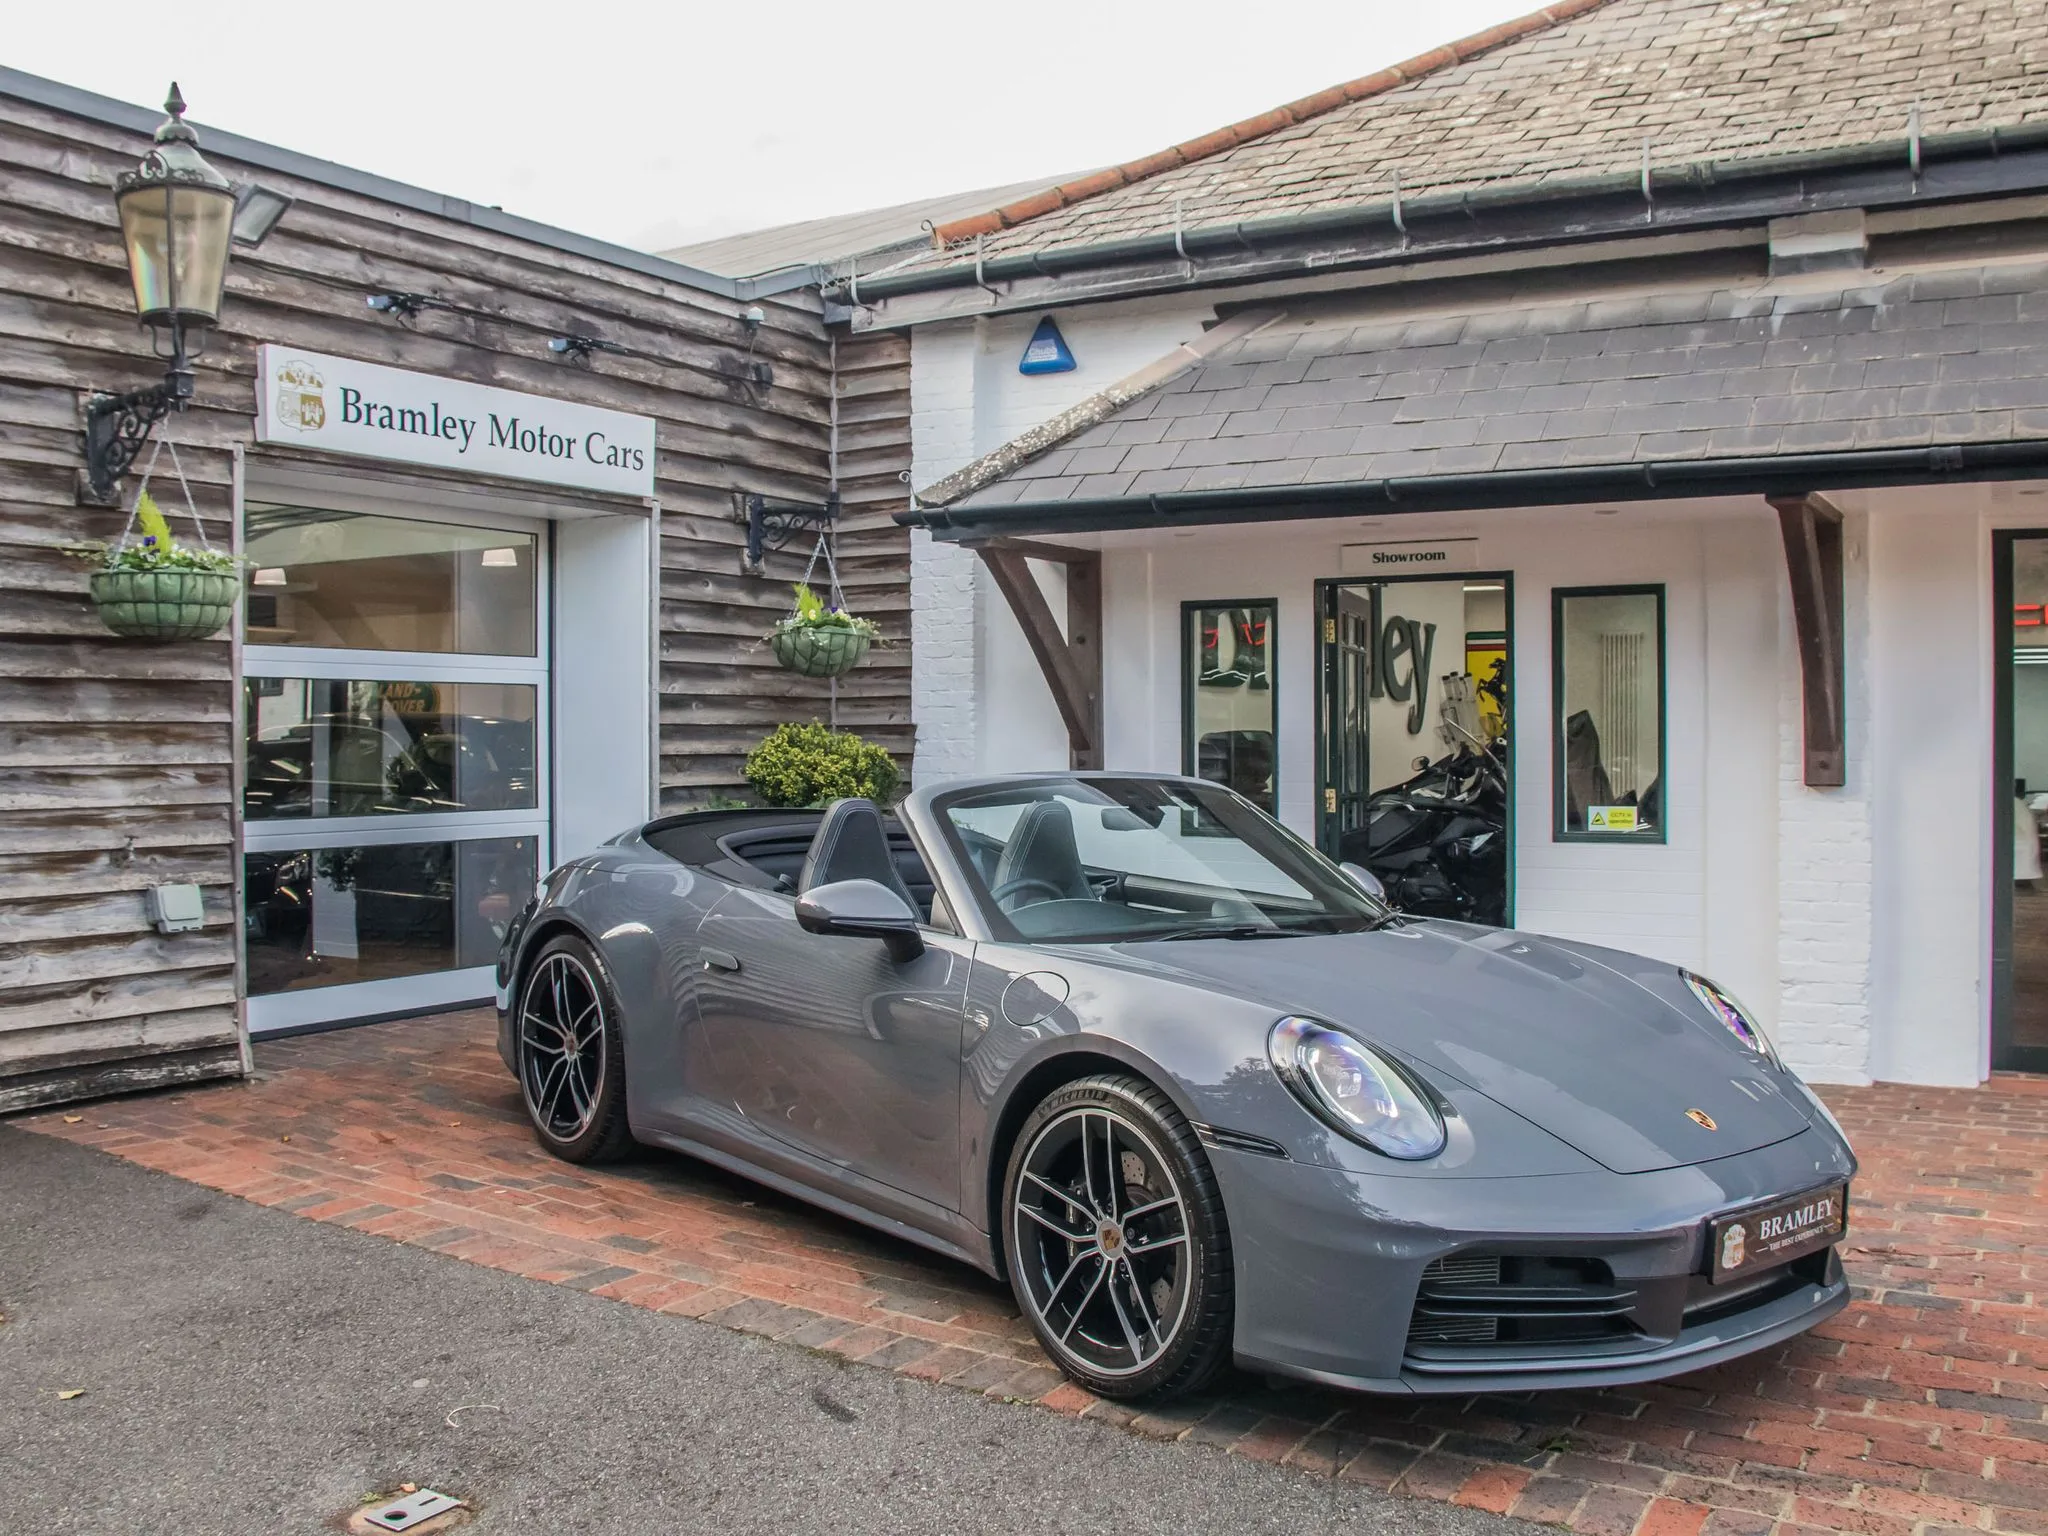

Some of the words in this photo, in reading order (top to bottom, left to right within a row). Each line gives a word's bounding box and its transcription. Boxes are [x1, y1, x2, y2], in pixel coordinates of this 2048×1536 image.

[339, 386, 477, 454] Bramley
[487, 413, 577, 460] Motor
[585, 432, 645, 471] Cars
[1372, 551, 1446, 564] Showroom
[1051, 1089, 1105, 1109] MICHELIN
[1759, 1197, 1835, 1240] BRAMLEY
[1769, 1241, 1781, 1252] THE
